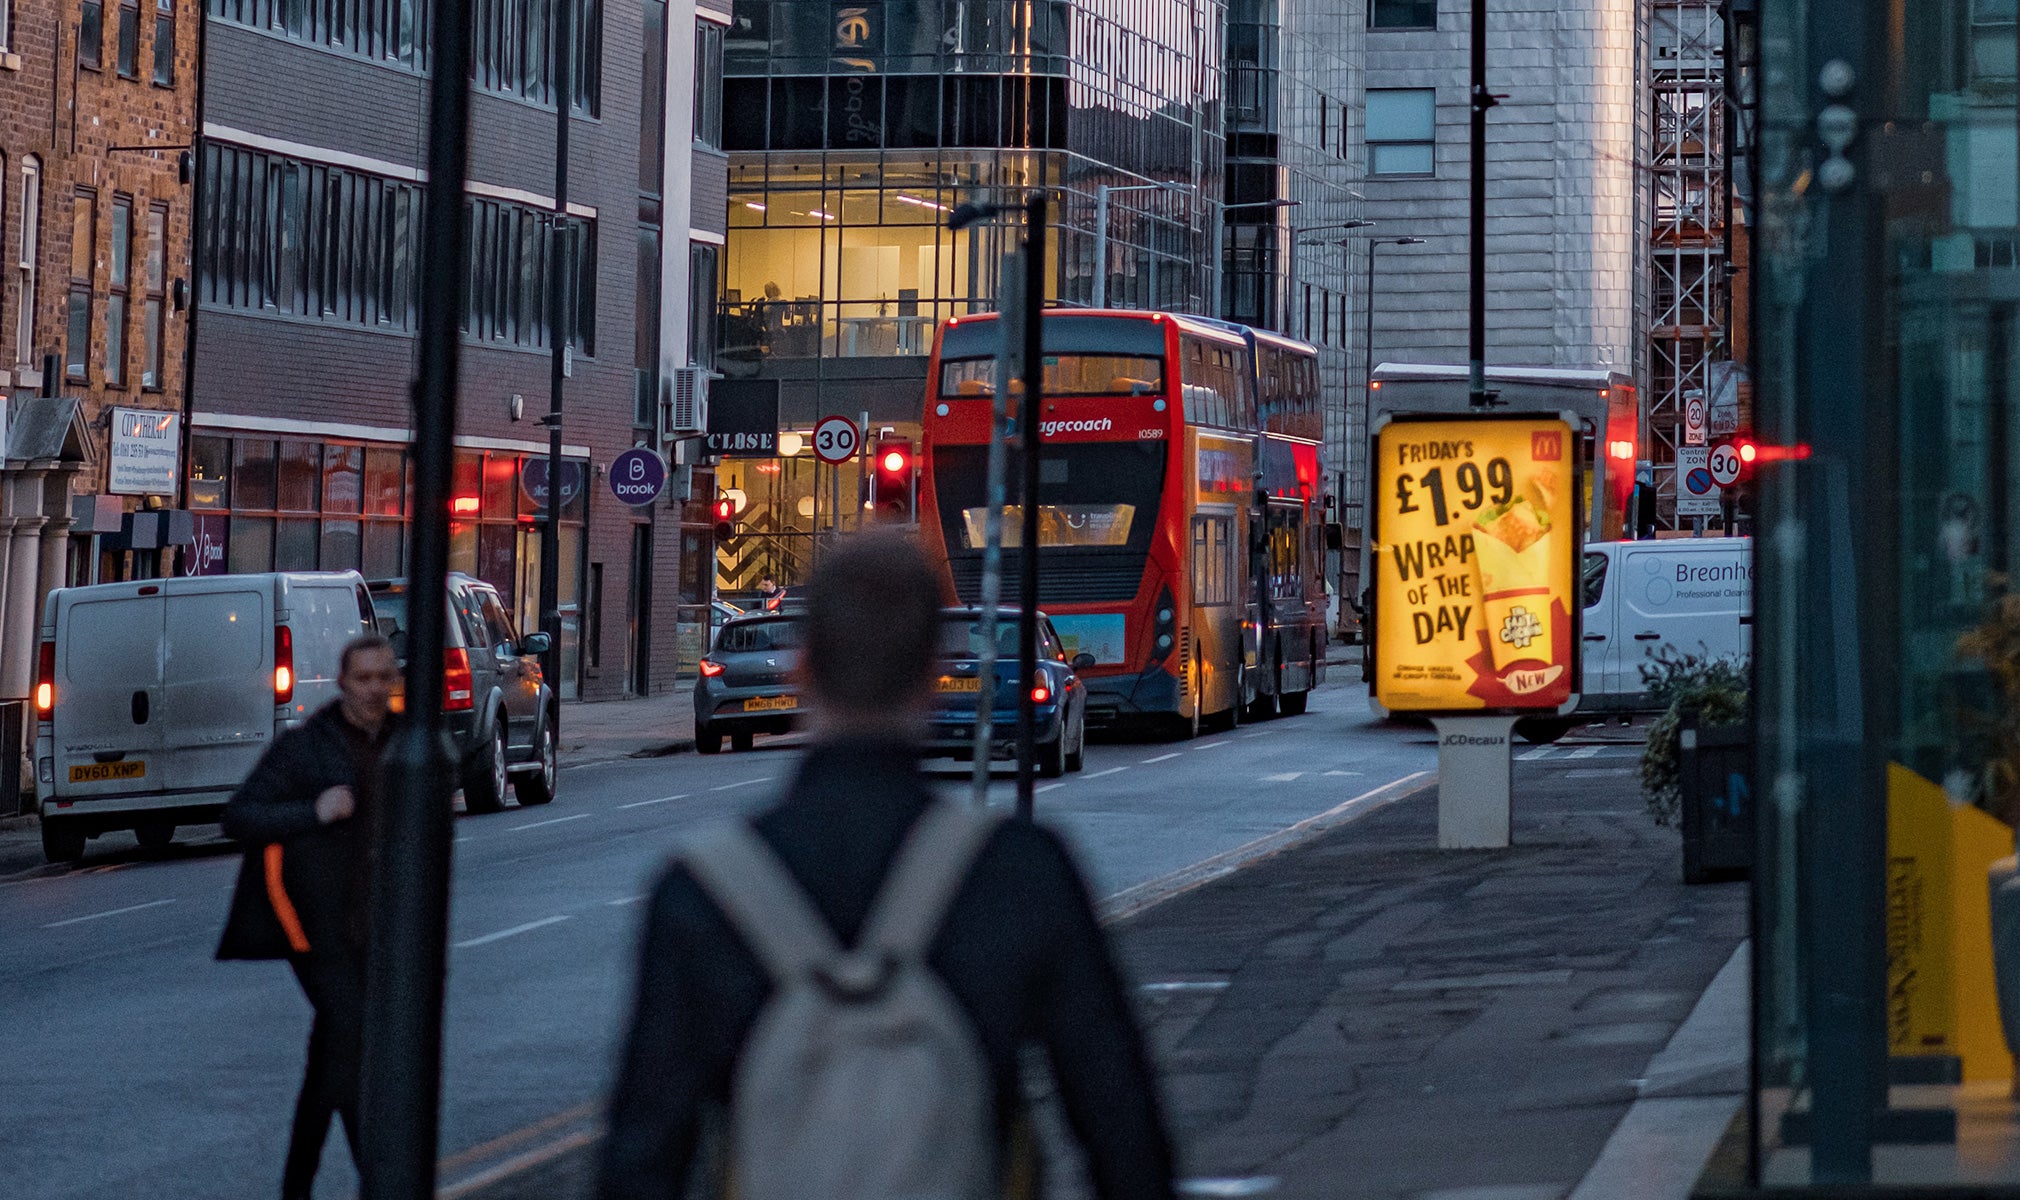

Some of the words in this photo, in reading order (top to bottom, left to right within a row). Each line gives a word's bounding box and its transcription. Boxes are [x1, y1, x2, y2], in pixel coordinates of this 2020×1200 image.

[1690, 408, 1701, 420] 20
[1040, 417, 1112, 437] agecoach
[1138, 429, 1164, 439] 10589
[707, 432, 773, 450] CLOSE
[819, 429, 854, 450] 30
[1688, 433, 1703, 441] ZONE
[1397, 440, 1474, 466] FRIDAY'S
[1686, 457, 1706, 465] ZON
[1713, 454, 1740, 475] 30
[617, 483, 655, 495] brook
[1396, 456, 1514, 527] £1.99
[1393, 533, 1476, 582] WRAP
[1407, 584, 1429, 605] OF
[1433, 573, 1471, 598] THE
[1676, 589, 1721, 599] Professional
[1412, 605, 1472, 645] DAY
[1442, 734, 1506, 746] JCDecaux
[75, 766, 109, 780] DV60
[113, 763, 139, 778] XNP
